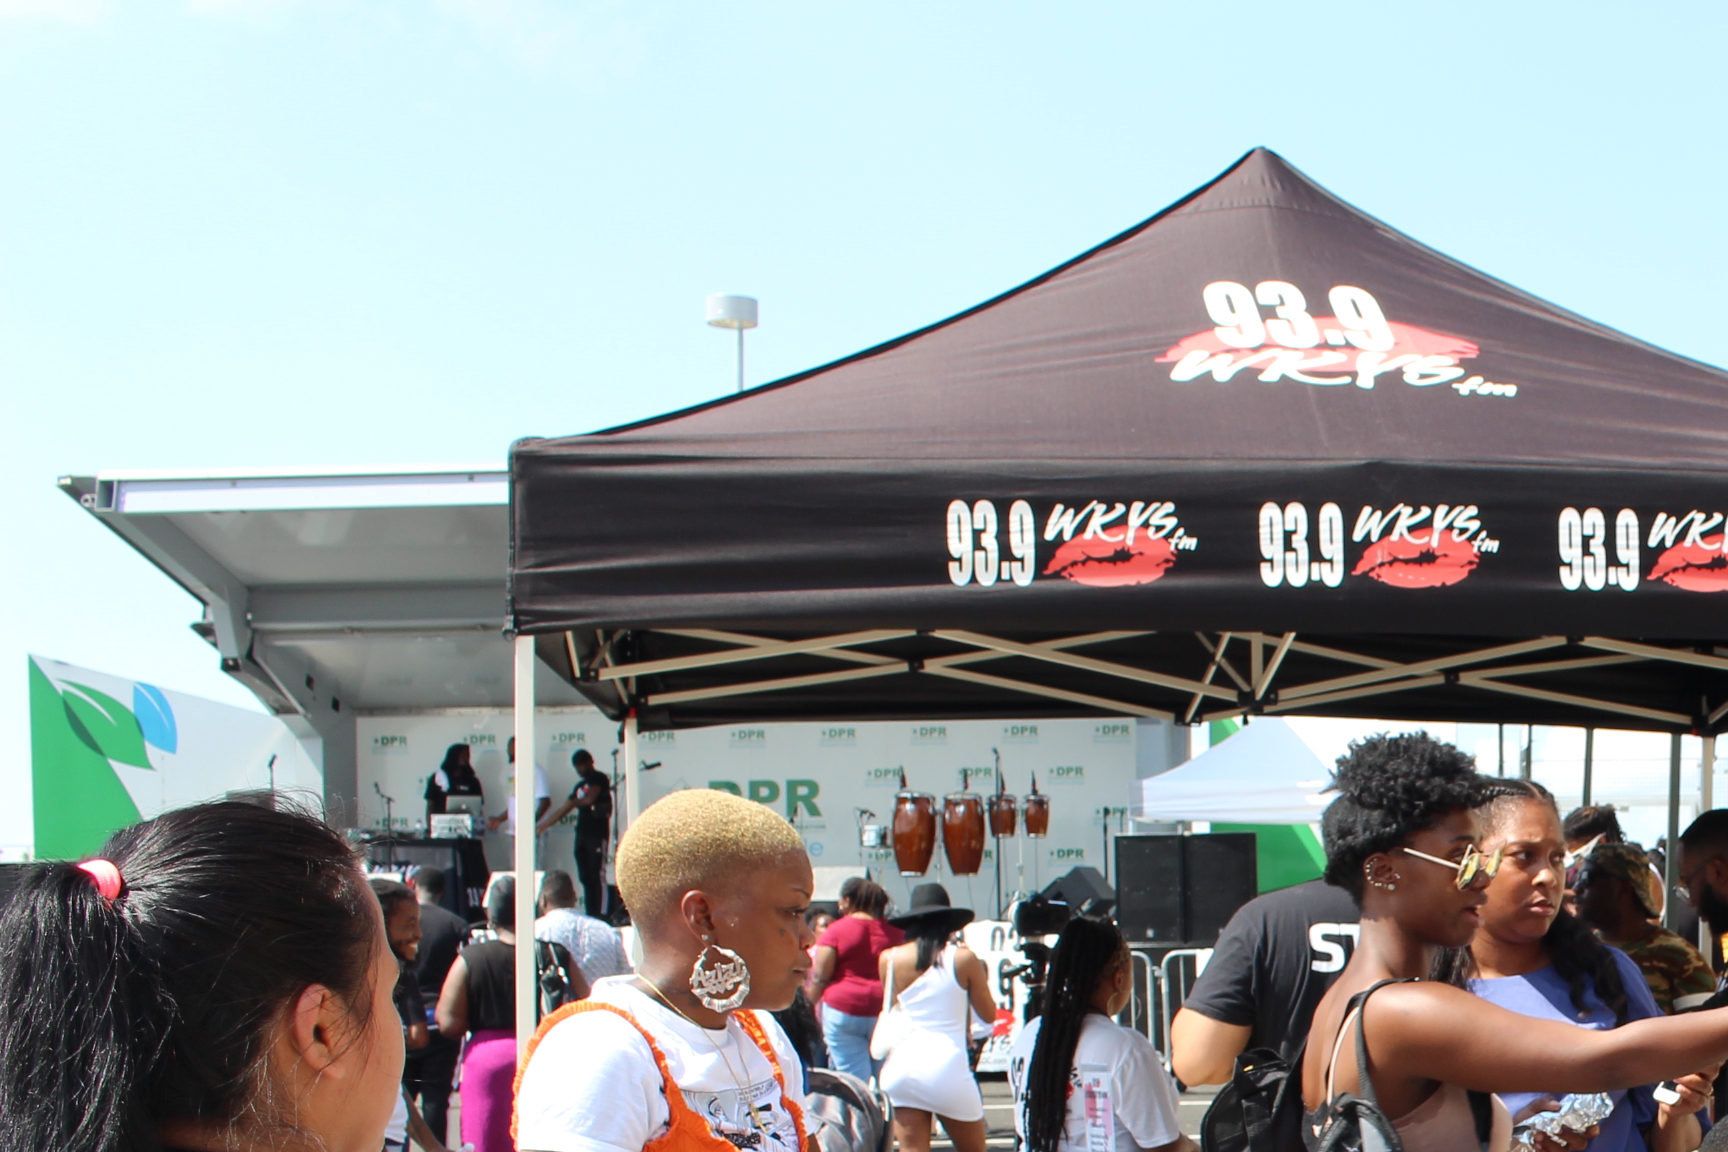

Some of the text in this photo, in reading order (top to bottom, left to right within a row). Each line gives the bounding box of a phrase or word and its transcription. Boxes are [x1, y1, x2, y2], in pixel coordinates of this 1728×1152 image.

[1203, 280, 1395, 351] 93.9
[946, 499, 1198, 587] 93.9 WKYS fm
[1258, 501, 1500, 588] 93.9 WKYS fm
[1558, 506, 1640, 591] 93.9
[738, 729, 765, 739] DPR
[829, 728, 855, 738] DPR
[919, 727, 947, 737] DPR
[1011, 725, 1038, 735] DPR
[1102, 725, 1130, 735] DPR
[381, 735, 407, 746] DPR
[470, 734, 496, 745] DPR
[559, 733, 586, 743] DPR
[1057, 766, 1084, 776] DPR
[1057, 849, 1084, 859] DPR
